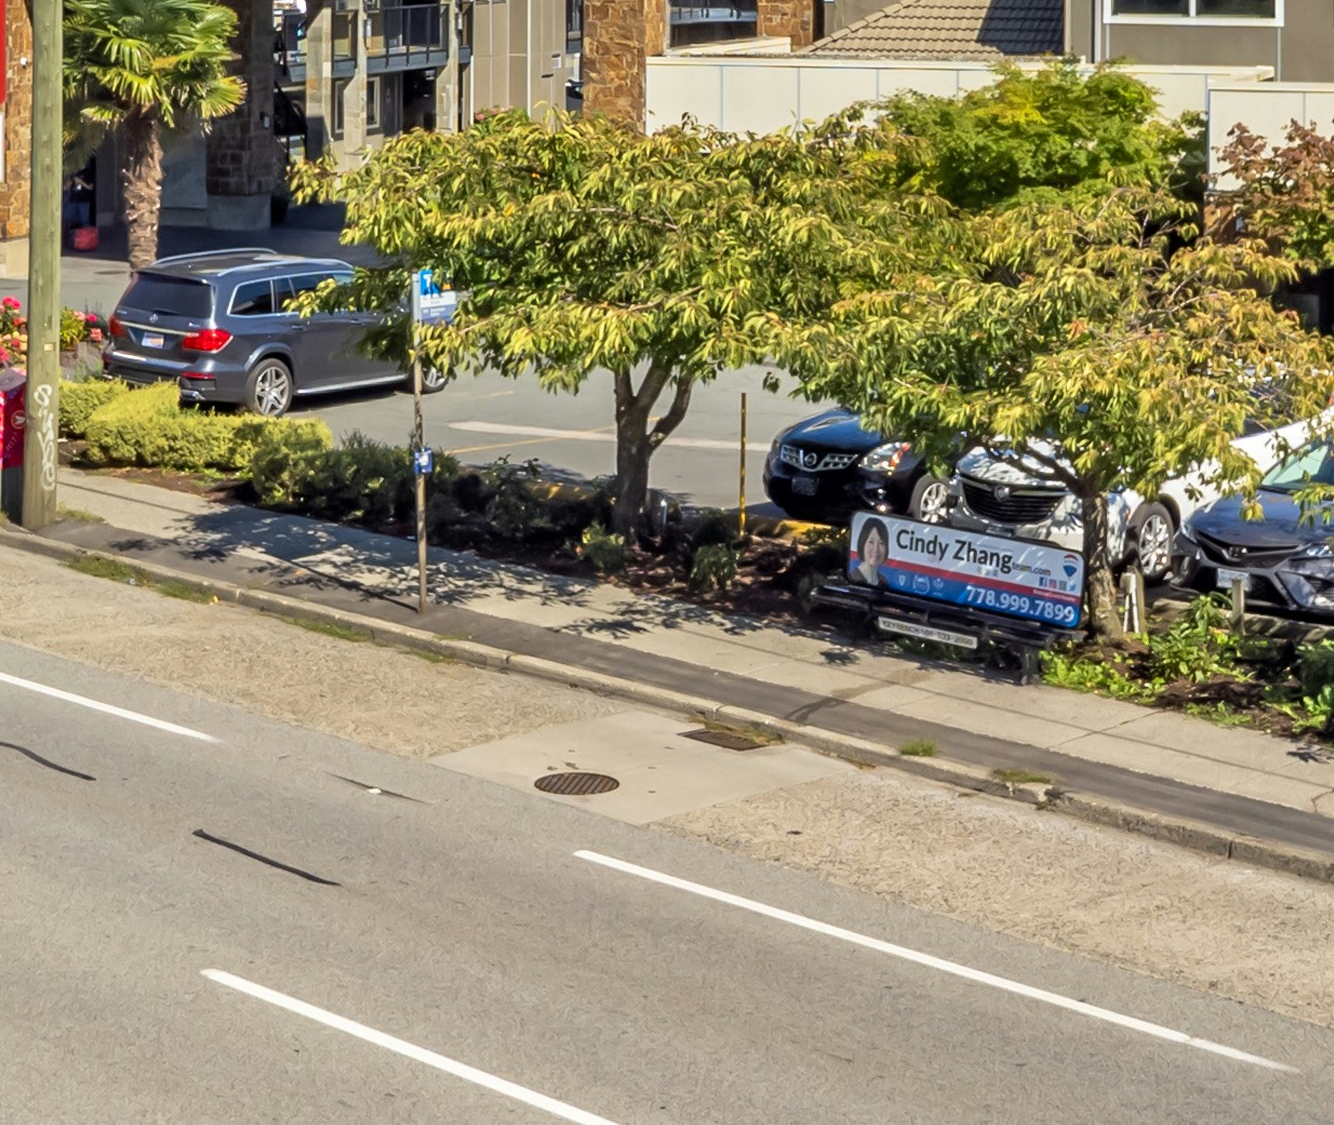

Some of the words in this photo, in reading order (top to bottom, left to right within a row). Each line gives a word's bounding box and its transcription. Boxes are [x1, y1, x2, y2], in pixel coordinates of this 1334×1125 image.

[896, 529, 949, 561] Cindy
[952, 539, 1013, 574] Zhang
[967, 585, 1075, 623] 778.999.7899
